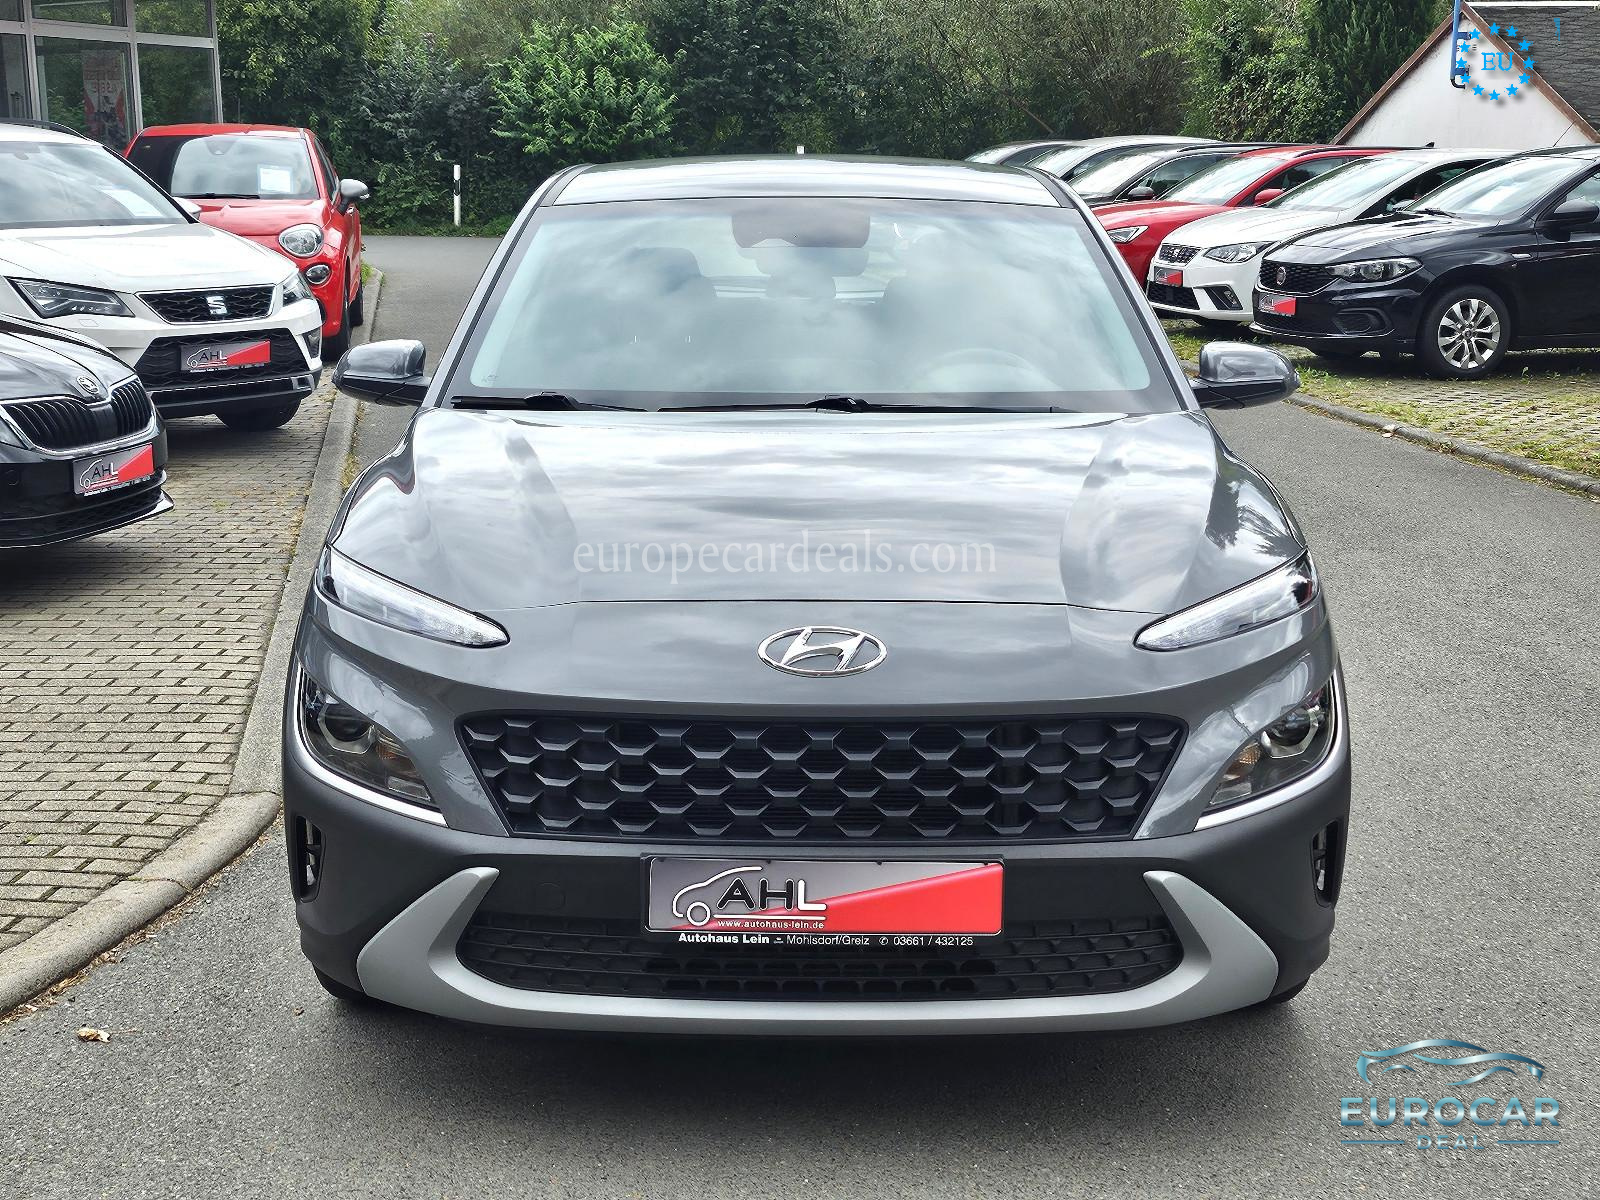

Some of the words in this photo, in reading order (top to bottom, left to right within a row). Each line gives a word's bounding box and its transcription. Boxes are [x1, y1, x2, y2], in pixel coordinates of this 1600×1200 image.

[200, 350, 227, 361] AHL
[92, 462, 118, 479] AHL
[716, 877, 827, 911] AHL
[717, 920, 825, 930] www.autohaus-lein.de
[678, 932, 739, 945] Autohaus
[742, 933, 770, 945] Lein
[893, 936, 925, 946] 03661
[935, 937, 974, 946] 432125
